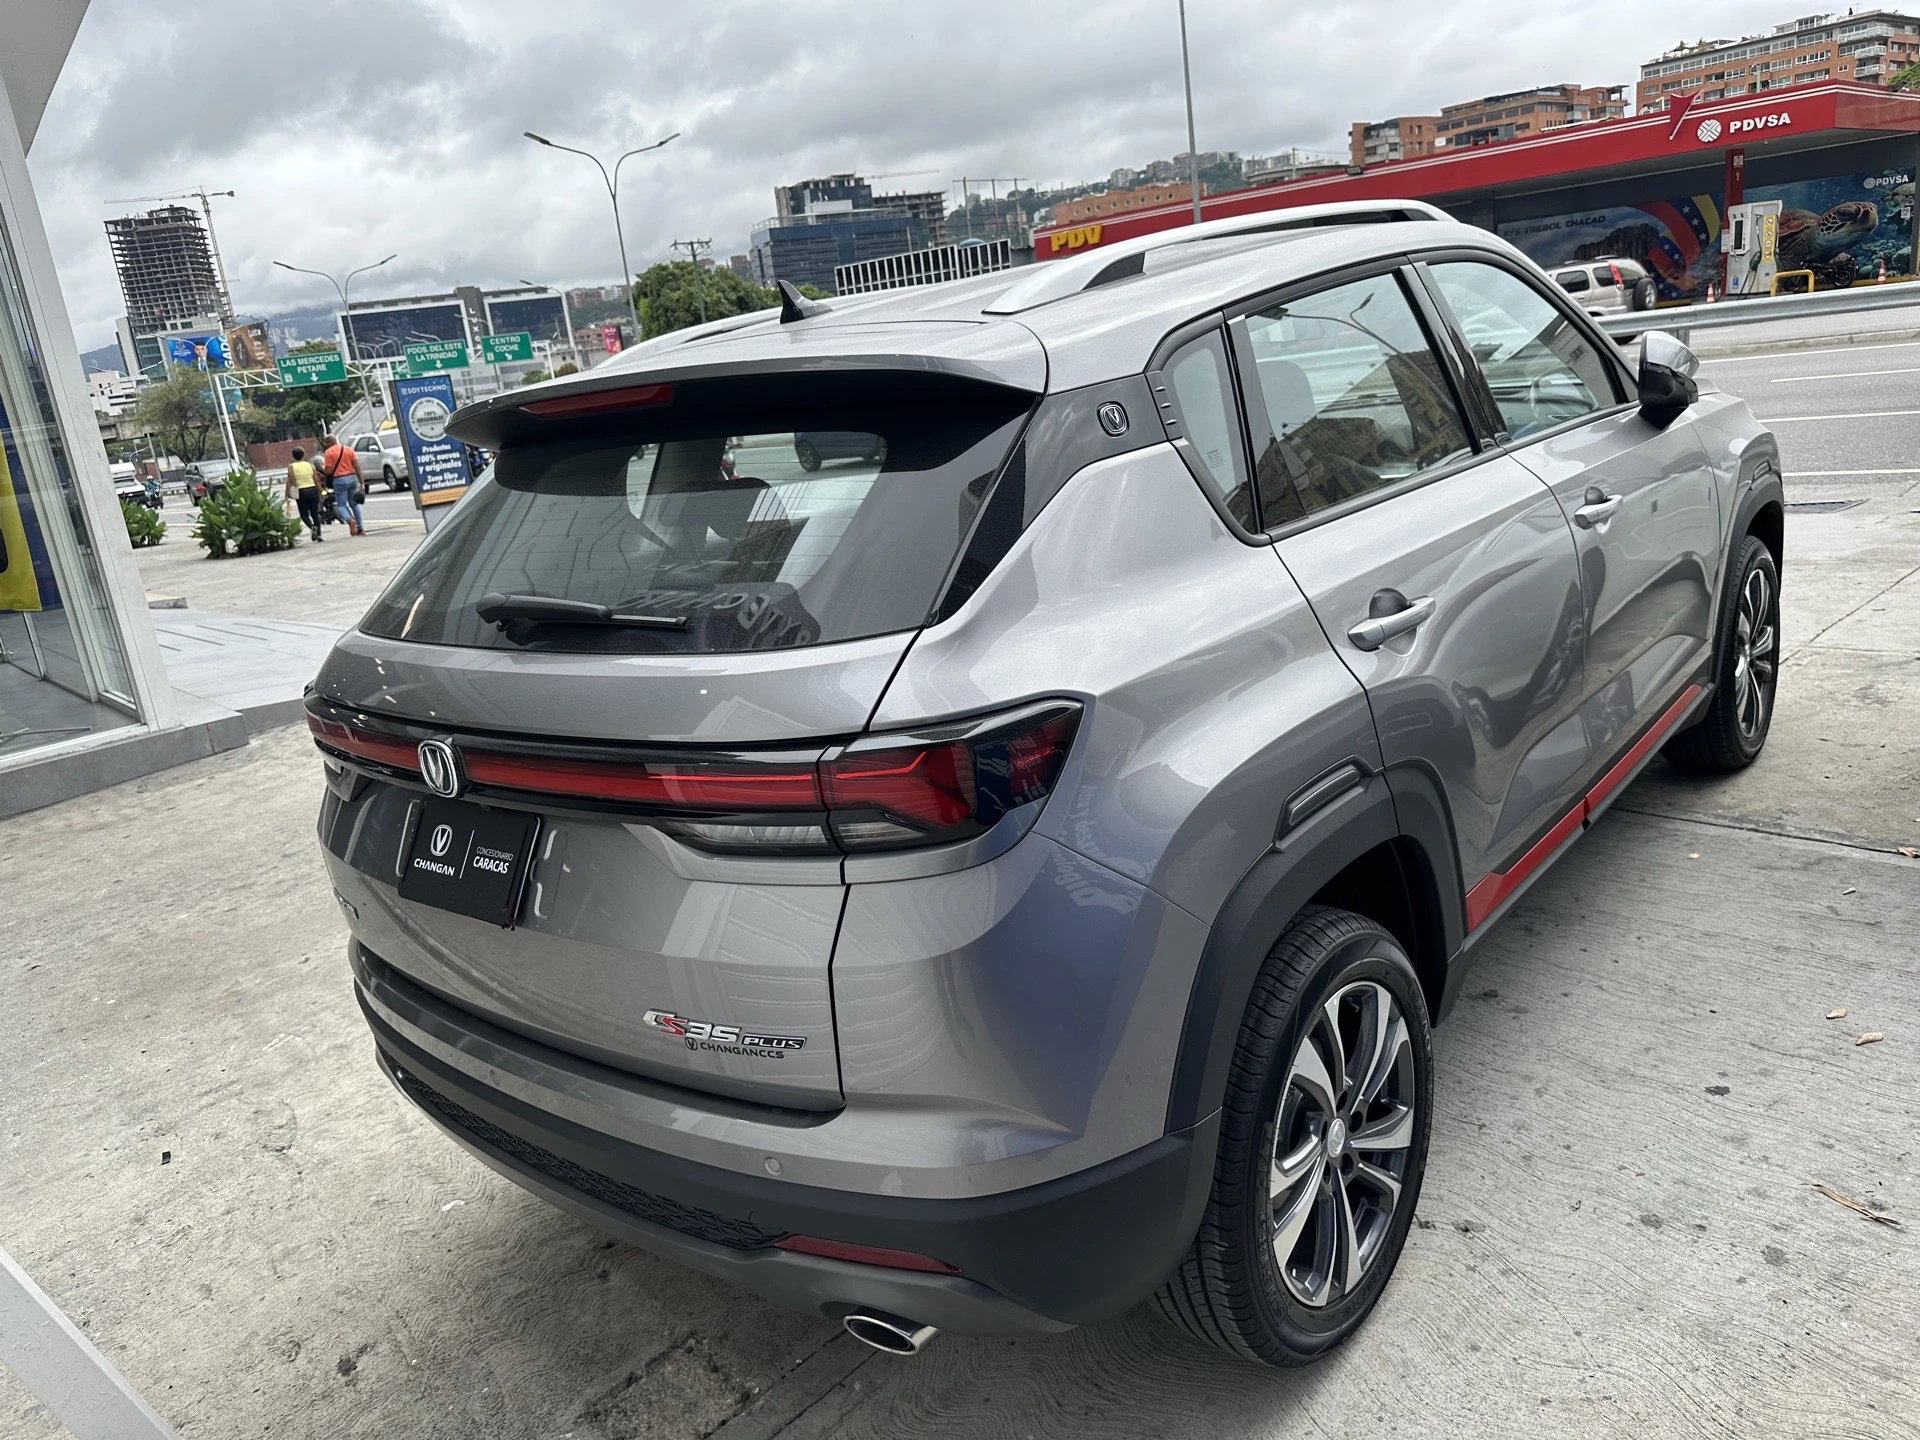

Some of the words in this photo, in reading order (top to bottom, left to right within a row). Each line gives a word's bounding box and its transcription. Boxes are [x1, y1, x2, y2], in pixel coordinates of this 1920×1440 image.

[1729, 112, 1791, 133] PDVSA
[1875, 174, 1909, 186] PDVSA
[1524, 222, 1562, 235] TREBOL
[1565, 215, 1606, 228] CHACAO
[1050, 224, 1102, 252] PDV
[489, 336, 521, 345] CENTRO
[429, 344, 443, 352] DEL
[444, 342, 463, 351] ESTE
[494, 344, 519, 353] COCHE
[280, 359, 297, 367] LAS
[297, 354, 340, 365] MERCEDES
[415, 354, 426, 362] LA
[426, 351, 458, 361] TRINIDAD
[297, 363, 327, 373] PETARE
[407, 384, 447, 395] SOYTECHNO
[422, 444, 451, 453] Productos
[417, 454, 436, 463] 100%
[437, 452, 460, 461] nuevos
[425, 460, 462, 472] originales
[444, 472, 458, 481] libre
[423, 482, 431, 491] de
[432, 477, 466, 489] refurbished
[476, 846, 514, 861] CONCESIONARIO
[413, 858, 456, 877] CHANGAN
[473, 855, 510, 874] CARACAS
[642, 1008, 742, 1043] CS35
[743, 1034, 803, 1050] PLUS
[700, 1042, 785, 1059] CHANGANCCS
